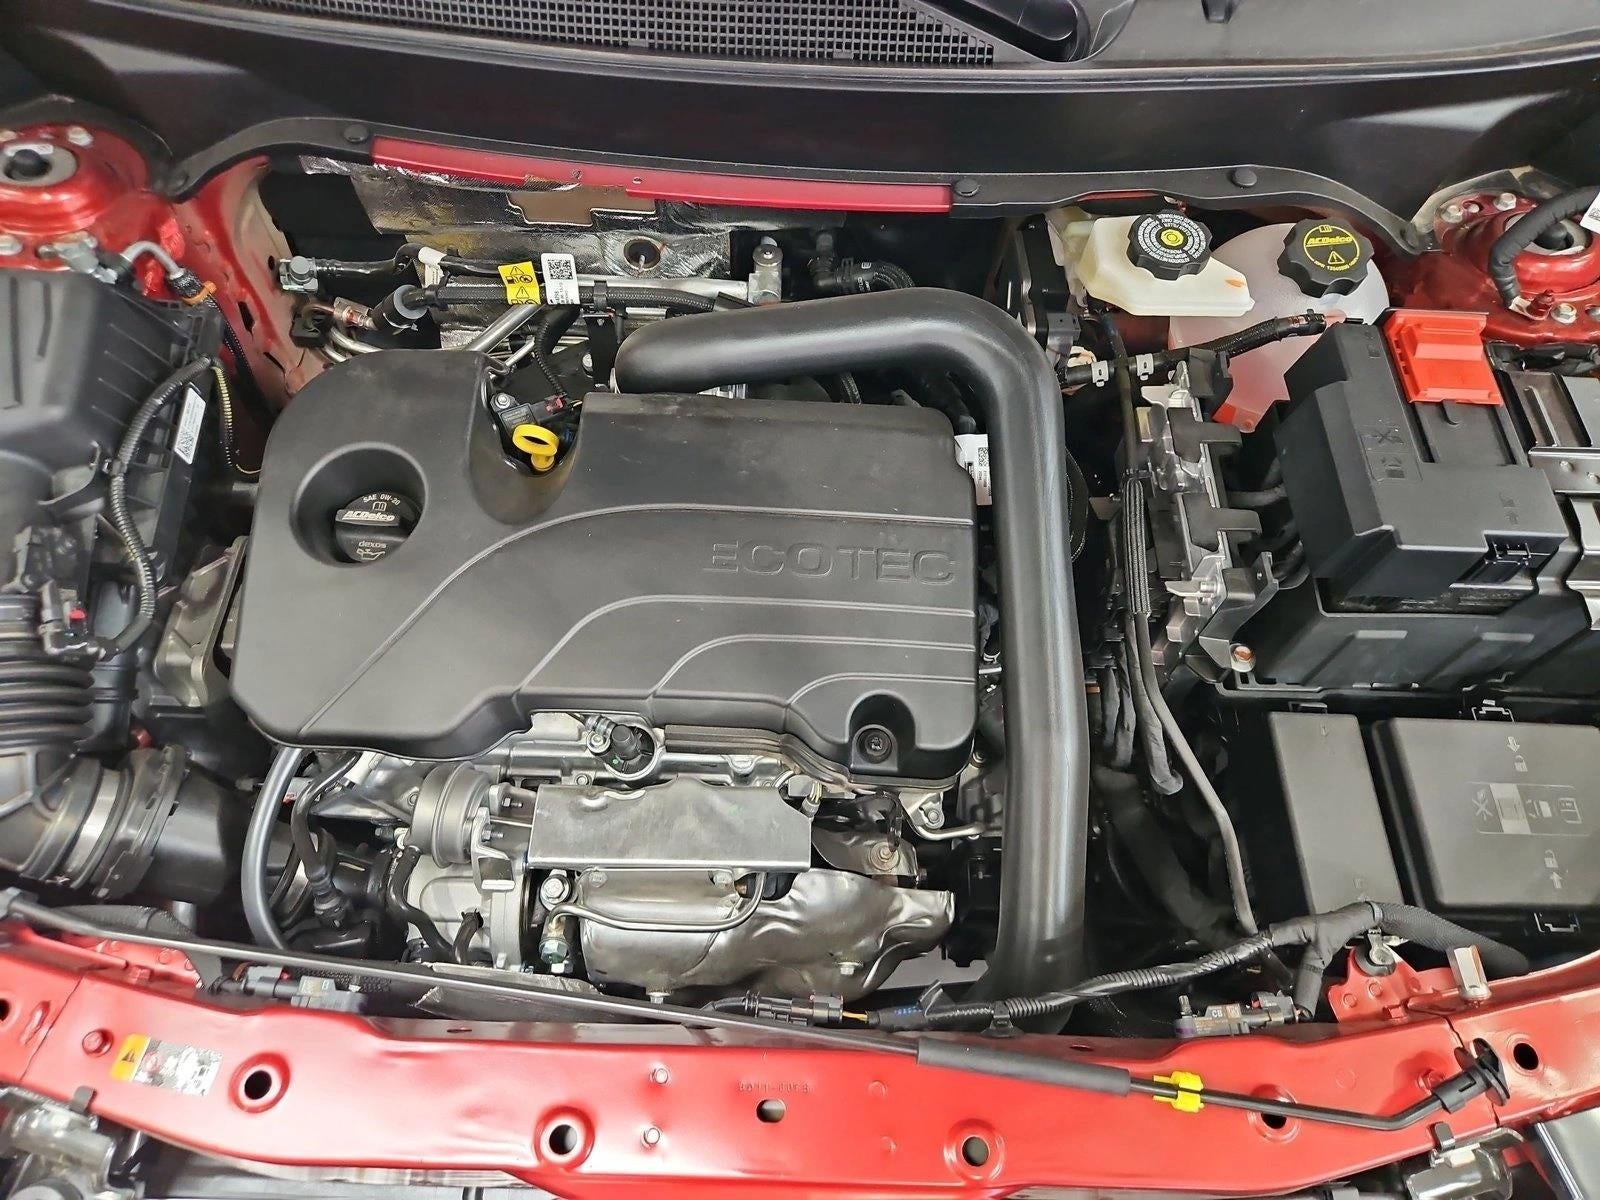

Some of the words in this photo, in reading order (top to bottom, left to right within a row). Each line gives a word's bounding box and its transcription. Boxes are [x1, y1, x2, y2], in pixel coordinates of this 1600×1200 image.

[1307, 236, 1353, 245] ACDelco
[363, 494, 377, 503] SAE
[380, 494, 400, 505] 0W-20
[342, 511, 395, 522] ACDelco
[359, 541, 386, 549] dexos
[703, 541, 956, 586] ECOTEC
